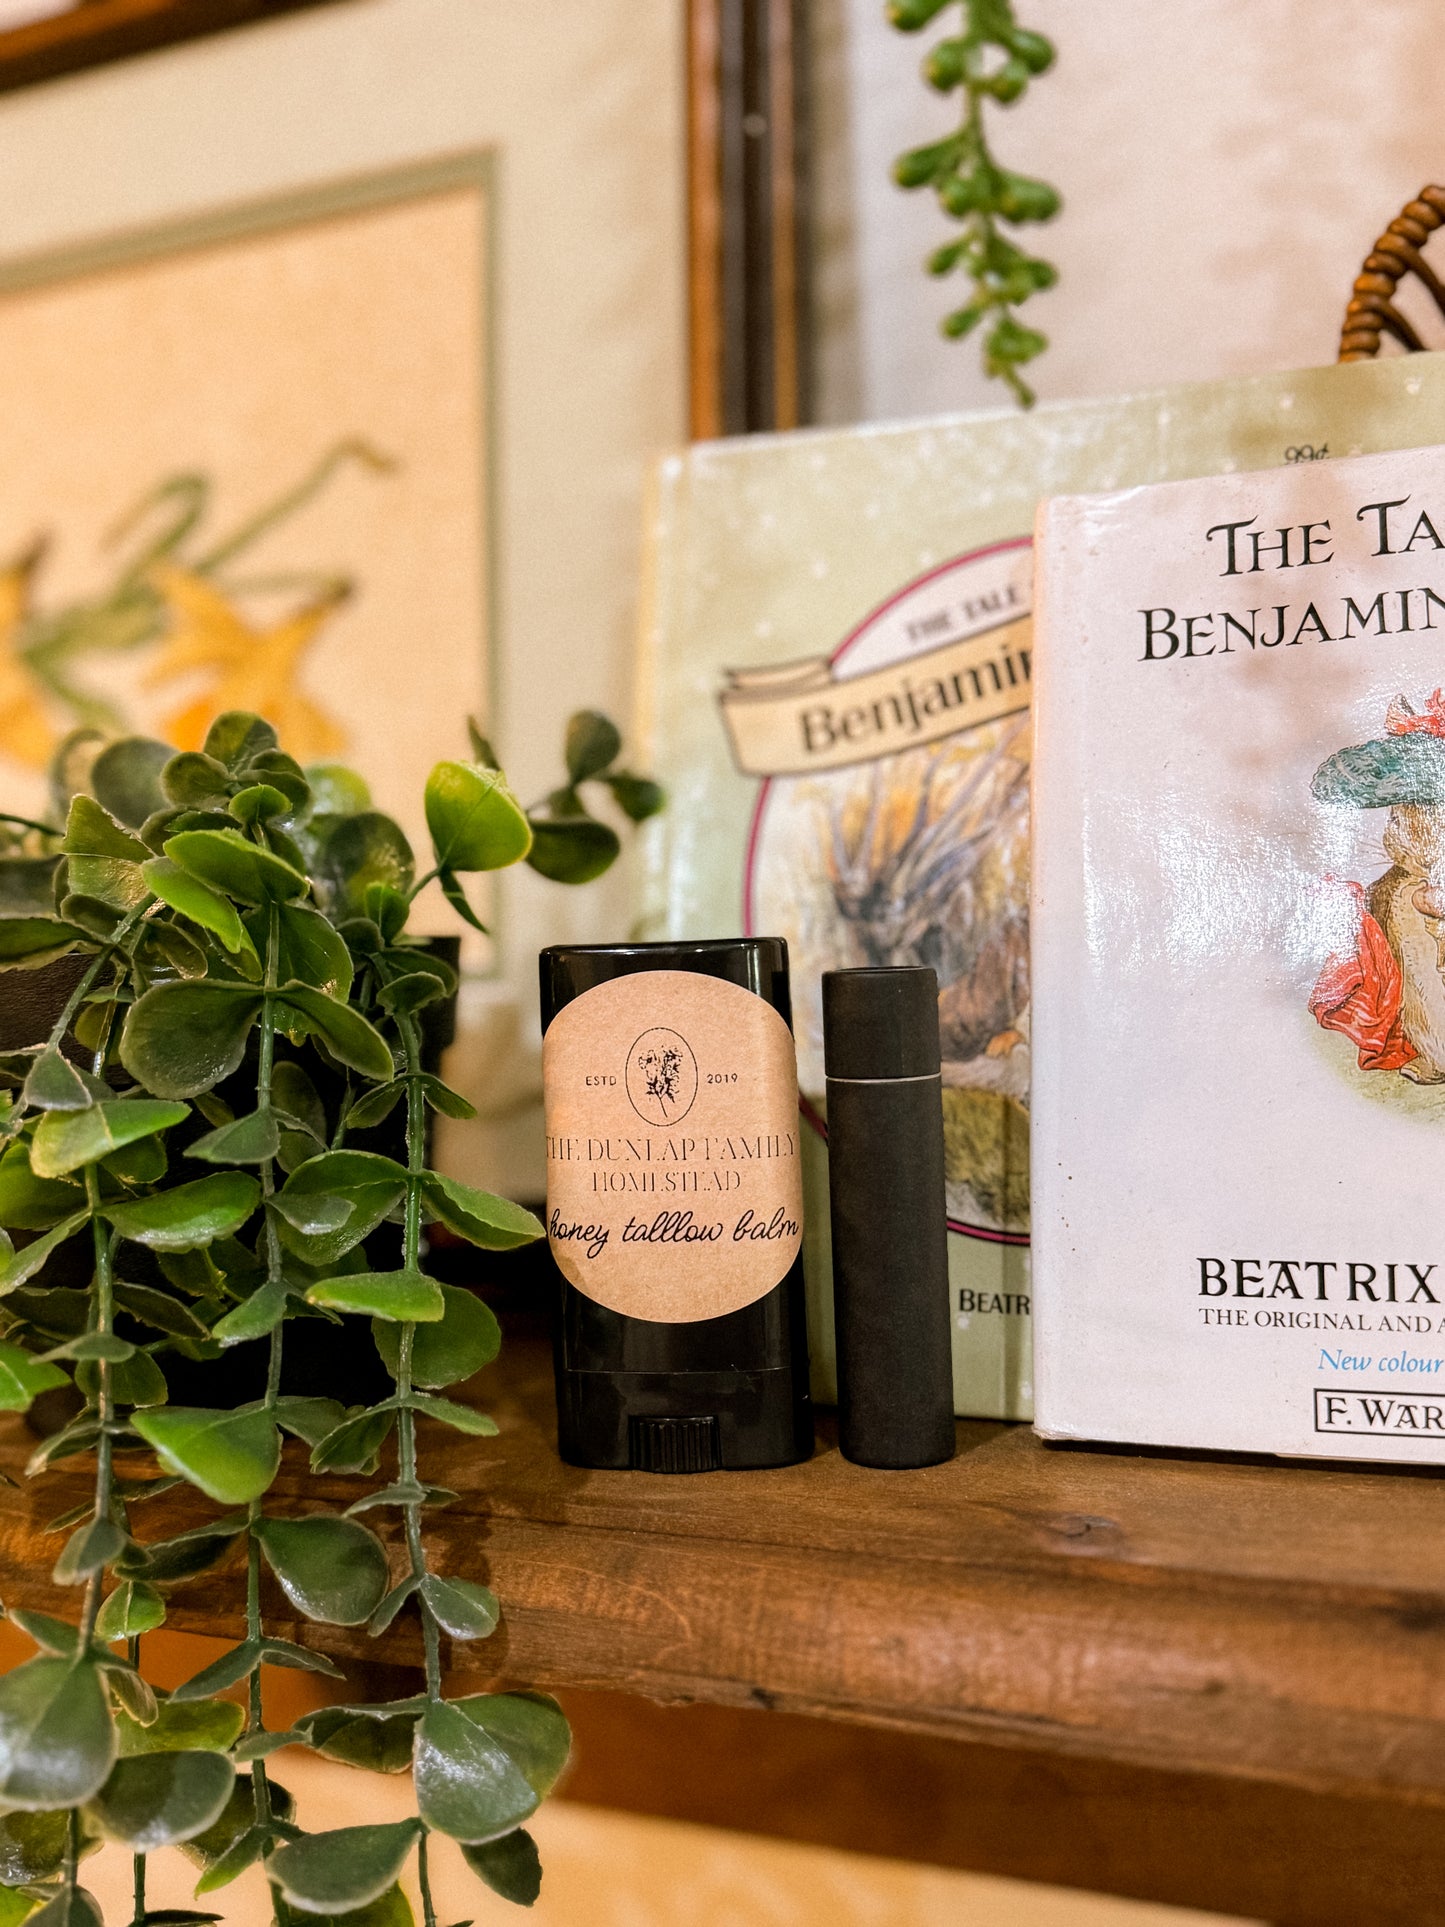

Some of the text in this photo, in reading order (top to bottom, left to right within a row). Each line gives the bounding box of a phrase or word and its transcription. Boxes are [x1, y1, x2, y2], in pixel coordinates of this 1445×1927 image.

[1206, 494, 1445, 577] THE TA
[965, 584, 1022, 621] TALE
[1137, 587, 1445, 662] BENJAMIN
[585, 1073, 738, 1086] ESTD 2019
[588, 1138, 695, 1161] DUNLAP
[705, 1132, 796, 1160] FAMILY
[592, 1171, 741, 1192] HOMESTEAD
[549, 1208, 610, 1259] honey
[732, 1206, 799, 1242] balm
[1197, 1257, 1441, 1304] BEATRIX
[1199, 1308, 1249, 1327] THE
[1254, 1310, 1372, 1331] ORIGINAL
[1378, 1315, 1432, 1333] AND
[1318, 1348, 1444, 1373] New colour
[1324, 1397, 1352, 1425] F.
